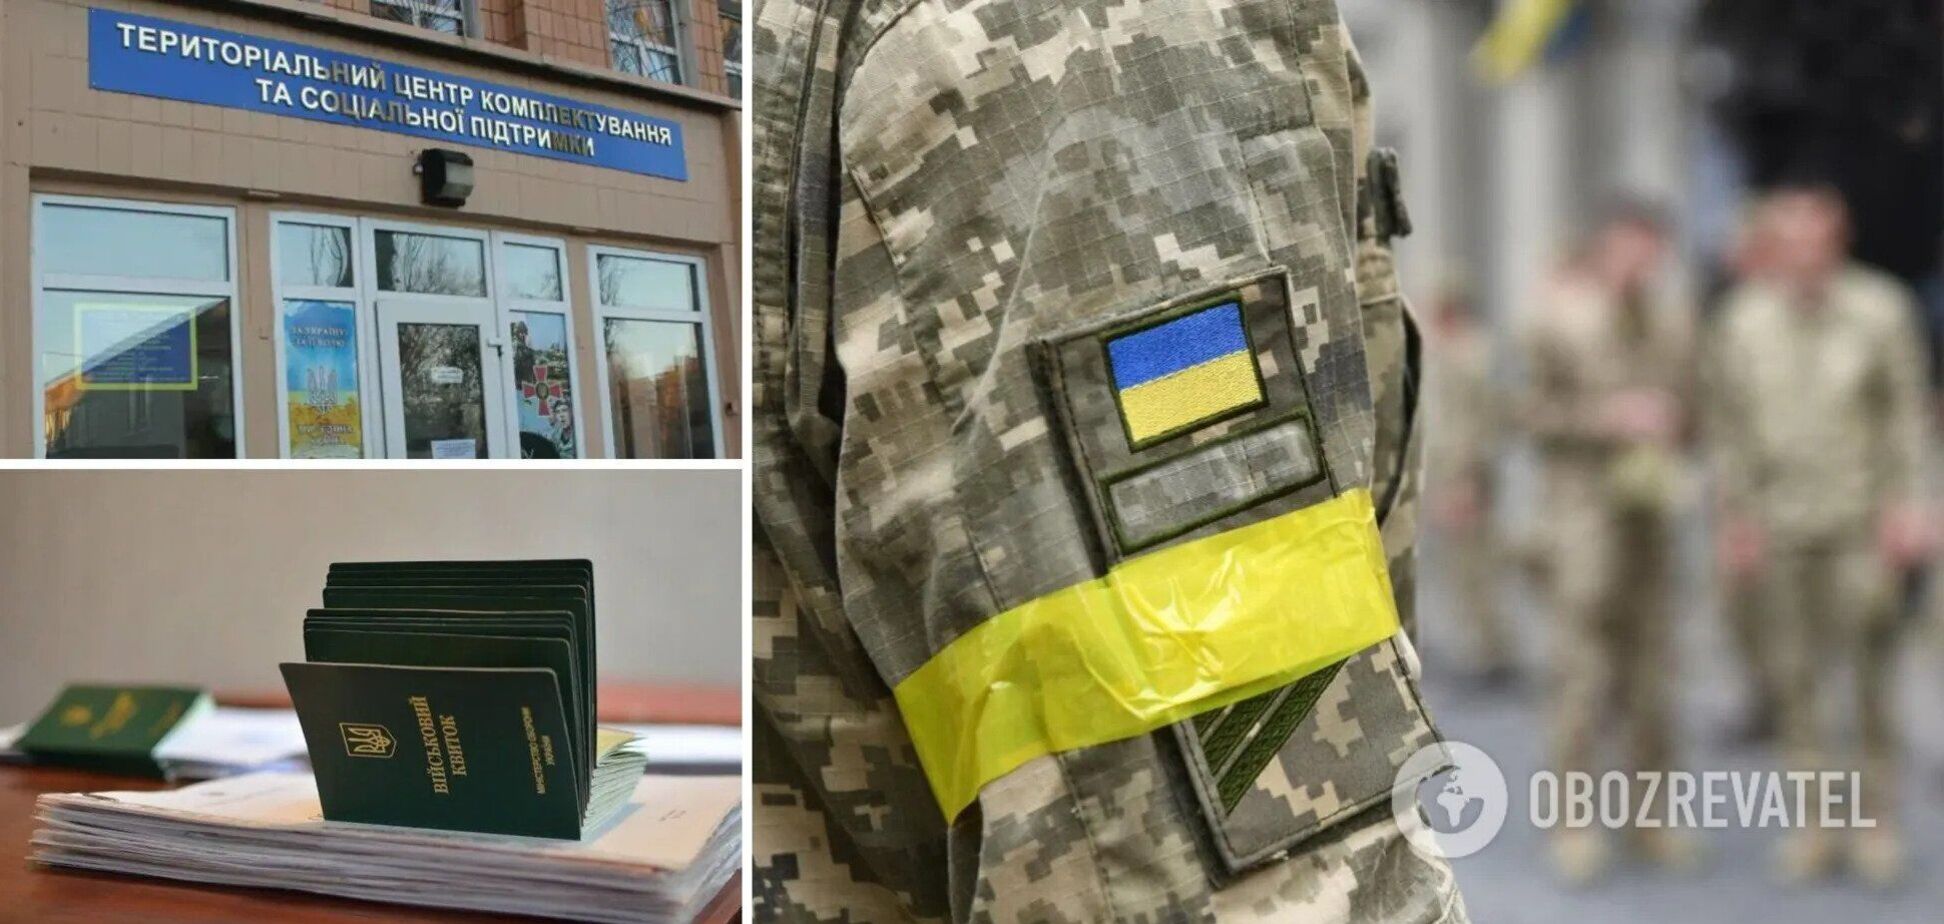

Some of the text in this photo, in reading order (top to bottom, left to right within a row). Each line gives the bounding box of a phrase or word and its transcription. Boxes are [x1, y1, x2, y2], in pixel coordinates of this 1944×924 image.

[116, 22, 673, 146] ТЕРИТОРІАЛЬНИЙ ЦЕНТР КОМПЛЕКТУВАННЯ
[255, 78, 595, 157] ТА СОЦІАЛЬНОЇ ПІДТРИМКИ
[408, 696, 449, 793] ВІЙСЬКОВИЙ
[439, 714, 468, 776] КВИТОК
